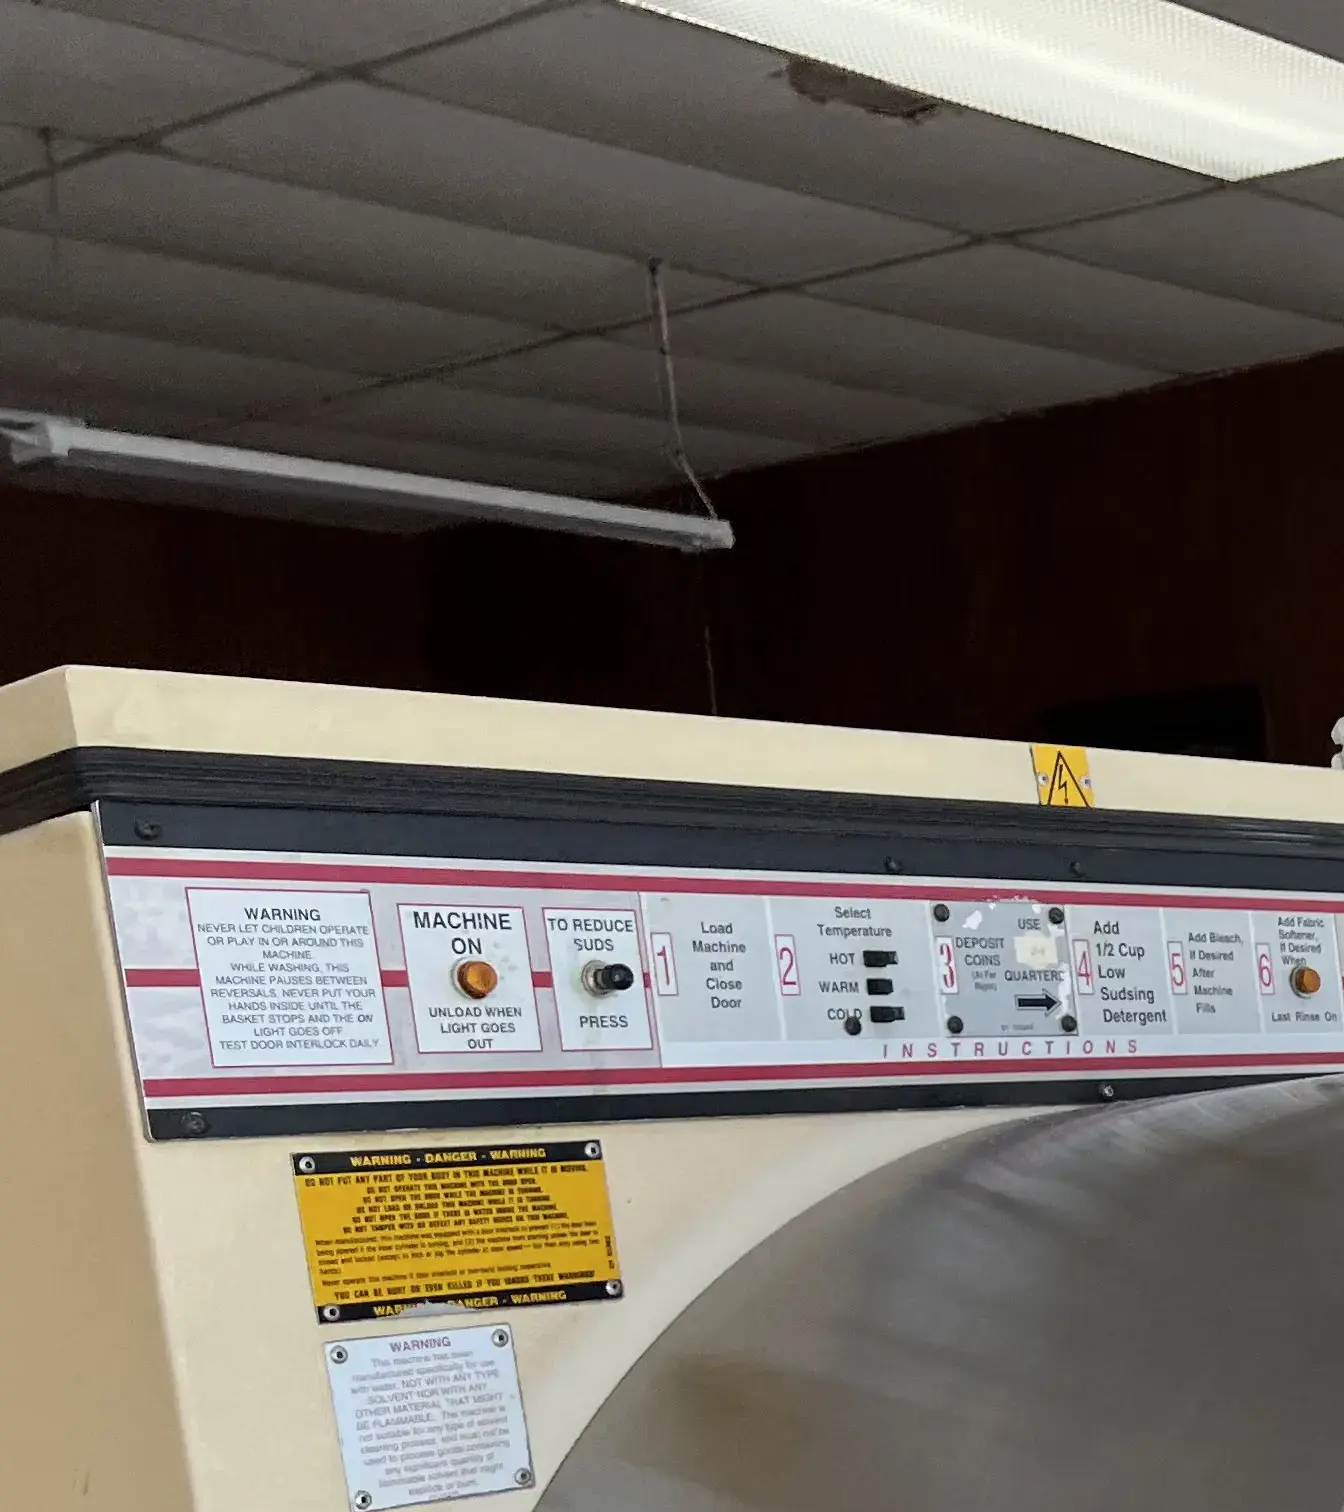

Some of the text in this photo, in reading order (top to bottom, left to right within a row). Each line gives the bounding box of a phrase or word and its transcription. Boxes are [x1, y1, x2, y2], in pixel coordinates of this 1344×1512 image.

[244, 907, 321, 921] WARNING
[834, 906, 871, 919] Select
[413, 911, 513, 930] MACHINE
[549, 918, 633, 933] TO REDUCE
[1018, 918, 1041, 930] USE
[1278, 916, 1324, 928] Add Fabric
[197, 923, 369, 935] NEVER LET CHILDREN OPERATE
[701, 921, 733, 934] Load
[817, 923, 893, 939] Temperature
[1094, 920, 1120, 935] Add
[207, 936, 364, 948] OR PLAY IN OR AROUND THIS
[573, 938, 615, 951] SUDS
[955, 936, 1004, 949] DEPOSIT
[1188, 932, 1244, 946] Add Bleach,
[451, 937, 483, 955] ON
[692, 940, 746, 953] Machine
[1095, 943, 1145, 960] 1/2 Cup
[1280, 942, 1322, 954] If Desired
[829, 953, 856, 965] HOT
[964, 954, 1001, 966] COINS
[1189, 951, 1234, 961] If Desired
[1282, 956, 1307, 966] When
[230, 962, 265, 972] WHILE
[326, 962, 350, 972] THIS
[657, 946, 670, 985] 1
[709, 959, 733, 971] and
[779, 947, 797, 986] 2
[939, 943, 955, 988] 3
[1078, 951, 1093, 986] 4
[1171, 953, 1184, 987] 5
[1259, 953, 1272, 987] 6
[1098, 965, 1126, 979] Low
[1192, 968, 1215, 979] After
[215, 975, 368, 985] MACHINE PAUSES BETWEEN
[706, 977, 743, 990] Close
[282, 988, 320, 998] NEVER
[322, 988, 343, 998] PUT
[345, 988, 376, 998] YOUR
[819, 981, 860, 993] WARM
[1194, 985, 1233, 996] Machine
[1100, 987, 1155, 1004] Sudsing
[228, 1001, 363, 1011] HANDS INSIDE UNTIL THE
[711, 996, 742, 1009] Door
[1196, 1002, 1216, 1013] Fills
[428, 1006, 522, 1018] UNLOAD WHEN
[827, 1008, 863, 1021] COLD
[1103, 1009, 1167, 1026] Detergent
[1272, 1011, 1337, 1022] Last Rinse On
[222, 1014, 373, 1024] BASKET STOPS AND THE ON
[579, 1015, 629, 1028] PRESS
[253, 1027, 286, 1037] LIGHT
[288, 1026, 320, 1036] GOES
[440, 1022, 516, 1034] LIGHT GOES
[219, 1040, 247, 1050] TEST
[251, 1040, 283, 1050] DOOR
[286, 1039, 347, 1049] INTERLOCK
[467, 1038, 493, 1049] OUT
[883, 1039, 1137, 1058] INSTRUCTIONS
[350, 1148, 547, 1167] WARNING DANGER WARNING
[511, 1290, 567, 1304] WARNING
[390, 1336, 451, 1352] WARNING
